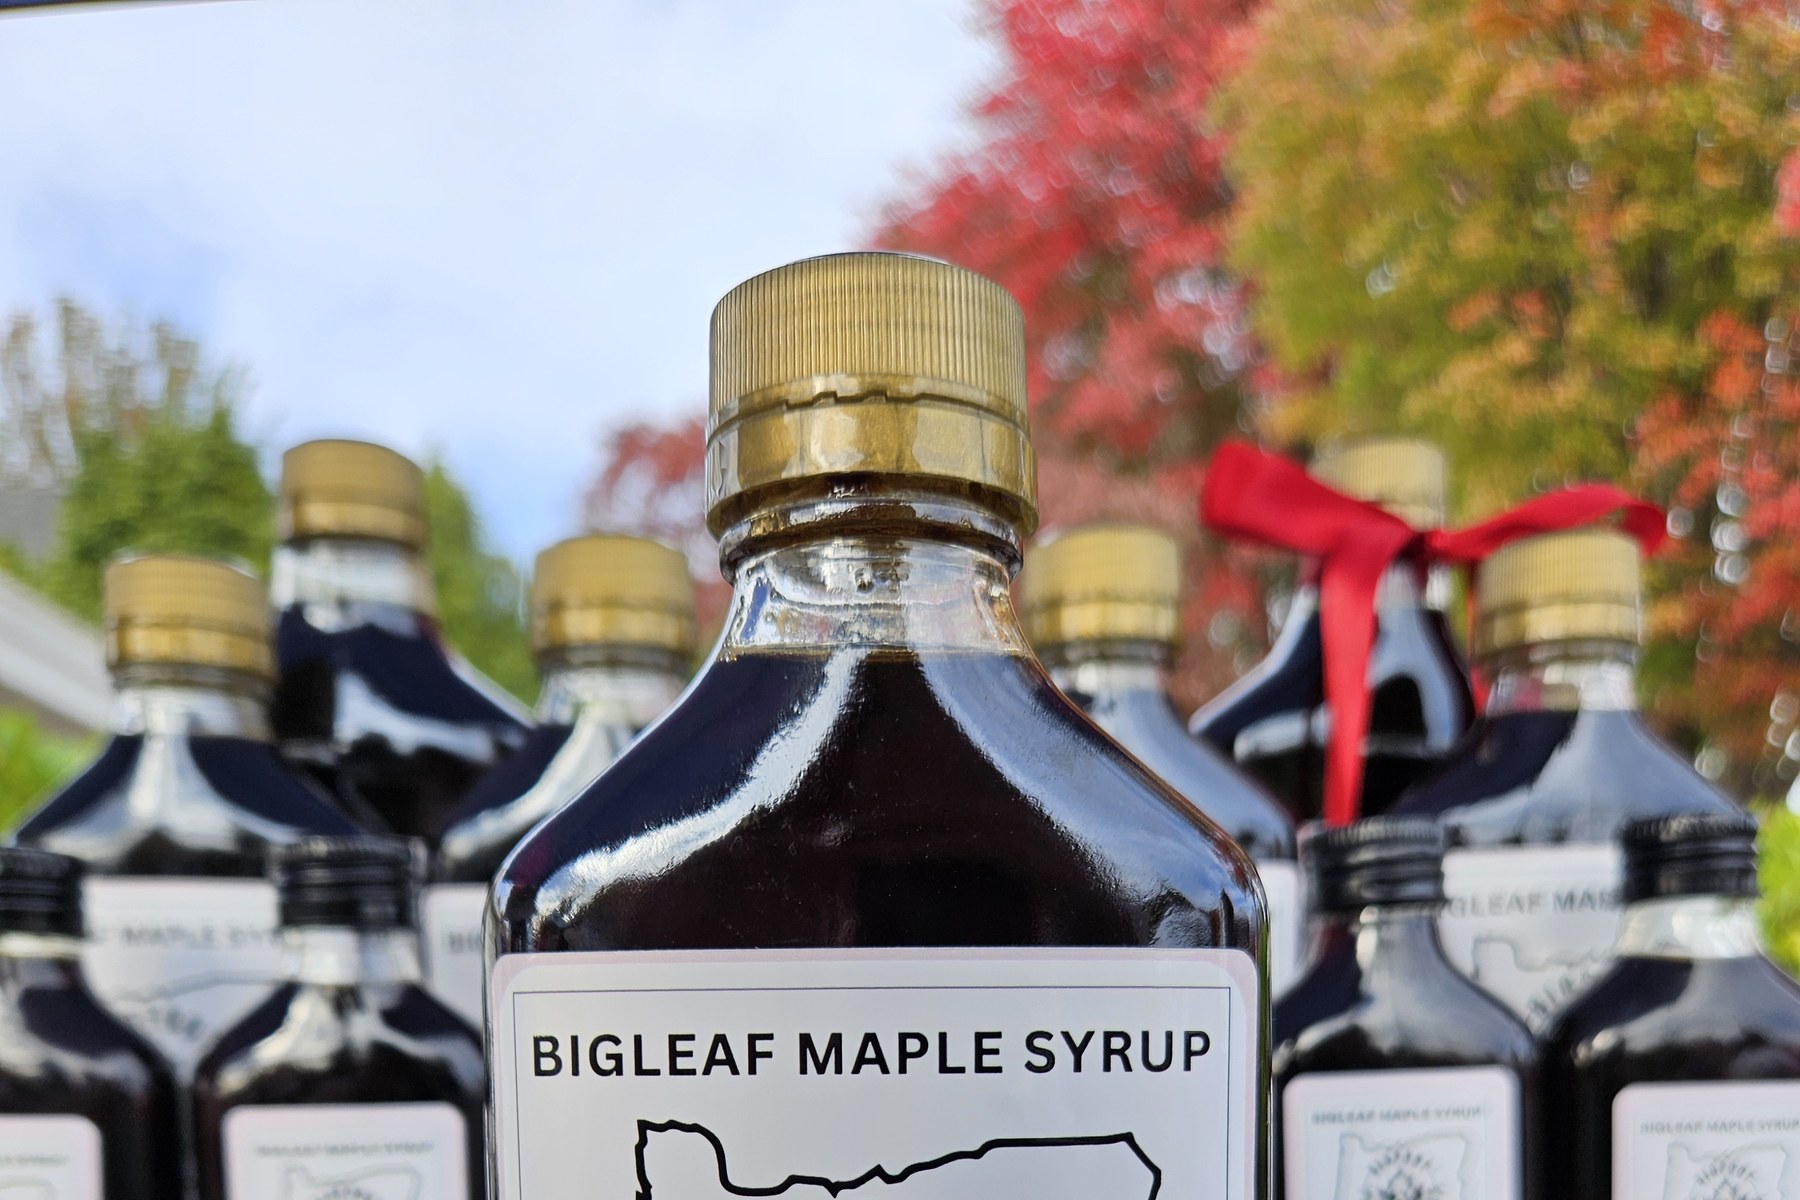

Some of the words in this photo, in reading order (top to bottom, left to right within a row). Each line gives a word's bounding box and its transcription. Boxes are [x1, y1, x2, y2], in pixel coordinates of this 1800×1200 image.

[533, 1033, 775, 1077] BIGLEAF
[799, 1031, 1004, 1076] MAPLE
[1025, 1030, 1212, 1074] SYRUP
